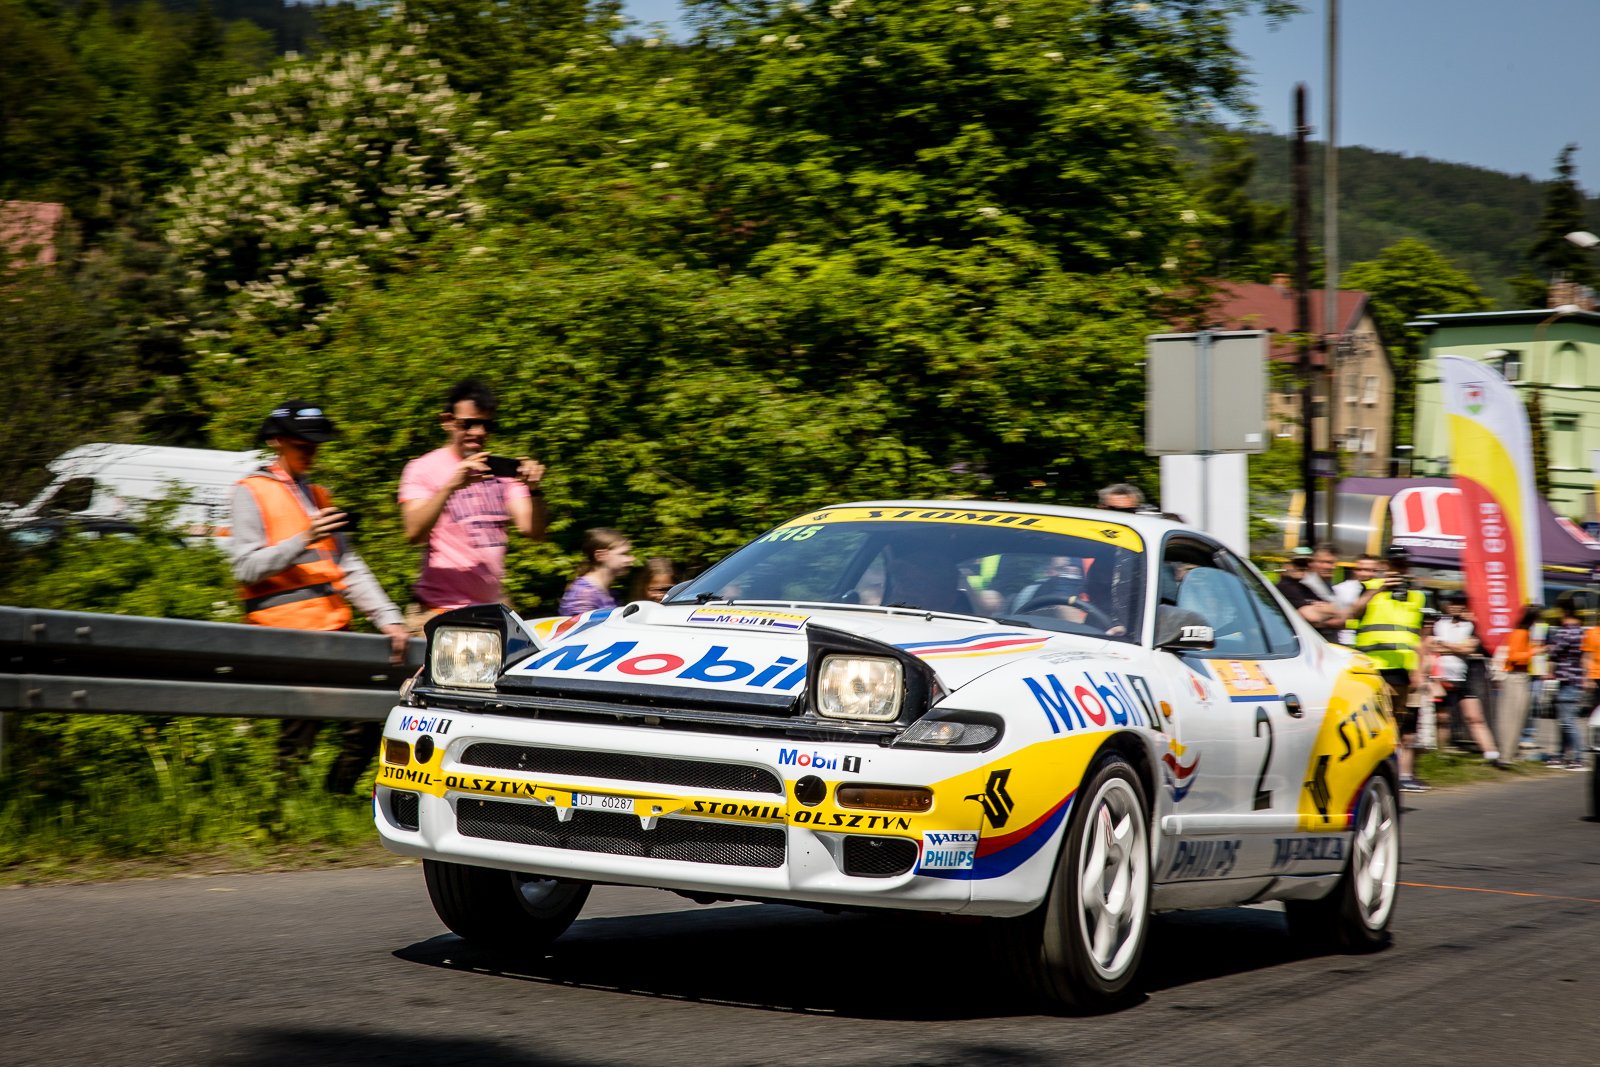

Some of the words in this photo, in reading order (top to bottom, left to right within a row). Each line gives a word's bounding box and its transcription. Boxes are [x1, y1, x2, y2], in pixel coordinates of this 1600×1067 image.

[856, 509, 1044, 528] STOMIL
[715, 615, 760, 625] Mobil
[1022, 671, 1144, 734] Mobil
[1126, 674, 1161, 732] 1
[399, 715, 437, 733] Mobil
[438, 719, 452, 734] 1
[778, 748, 837, 770] Mobil
[844, 755, 860, 773] 1
[1252, 706, 1273, 811] 2
[601, 797, 633, 811] 60287
[925, 833, 977, 846] WARTA
[924, 850, 974, 867] PHILIPS
